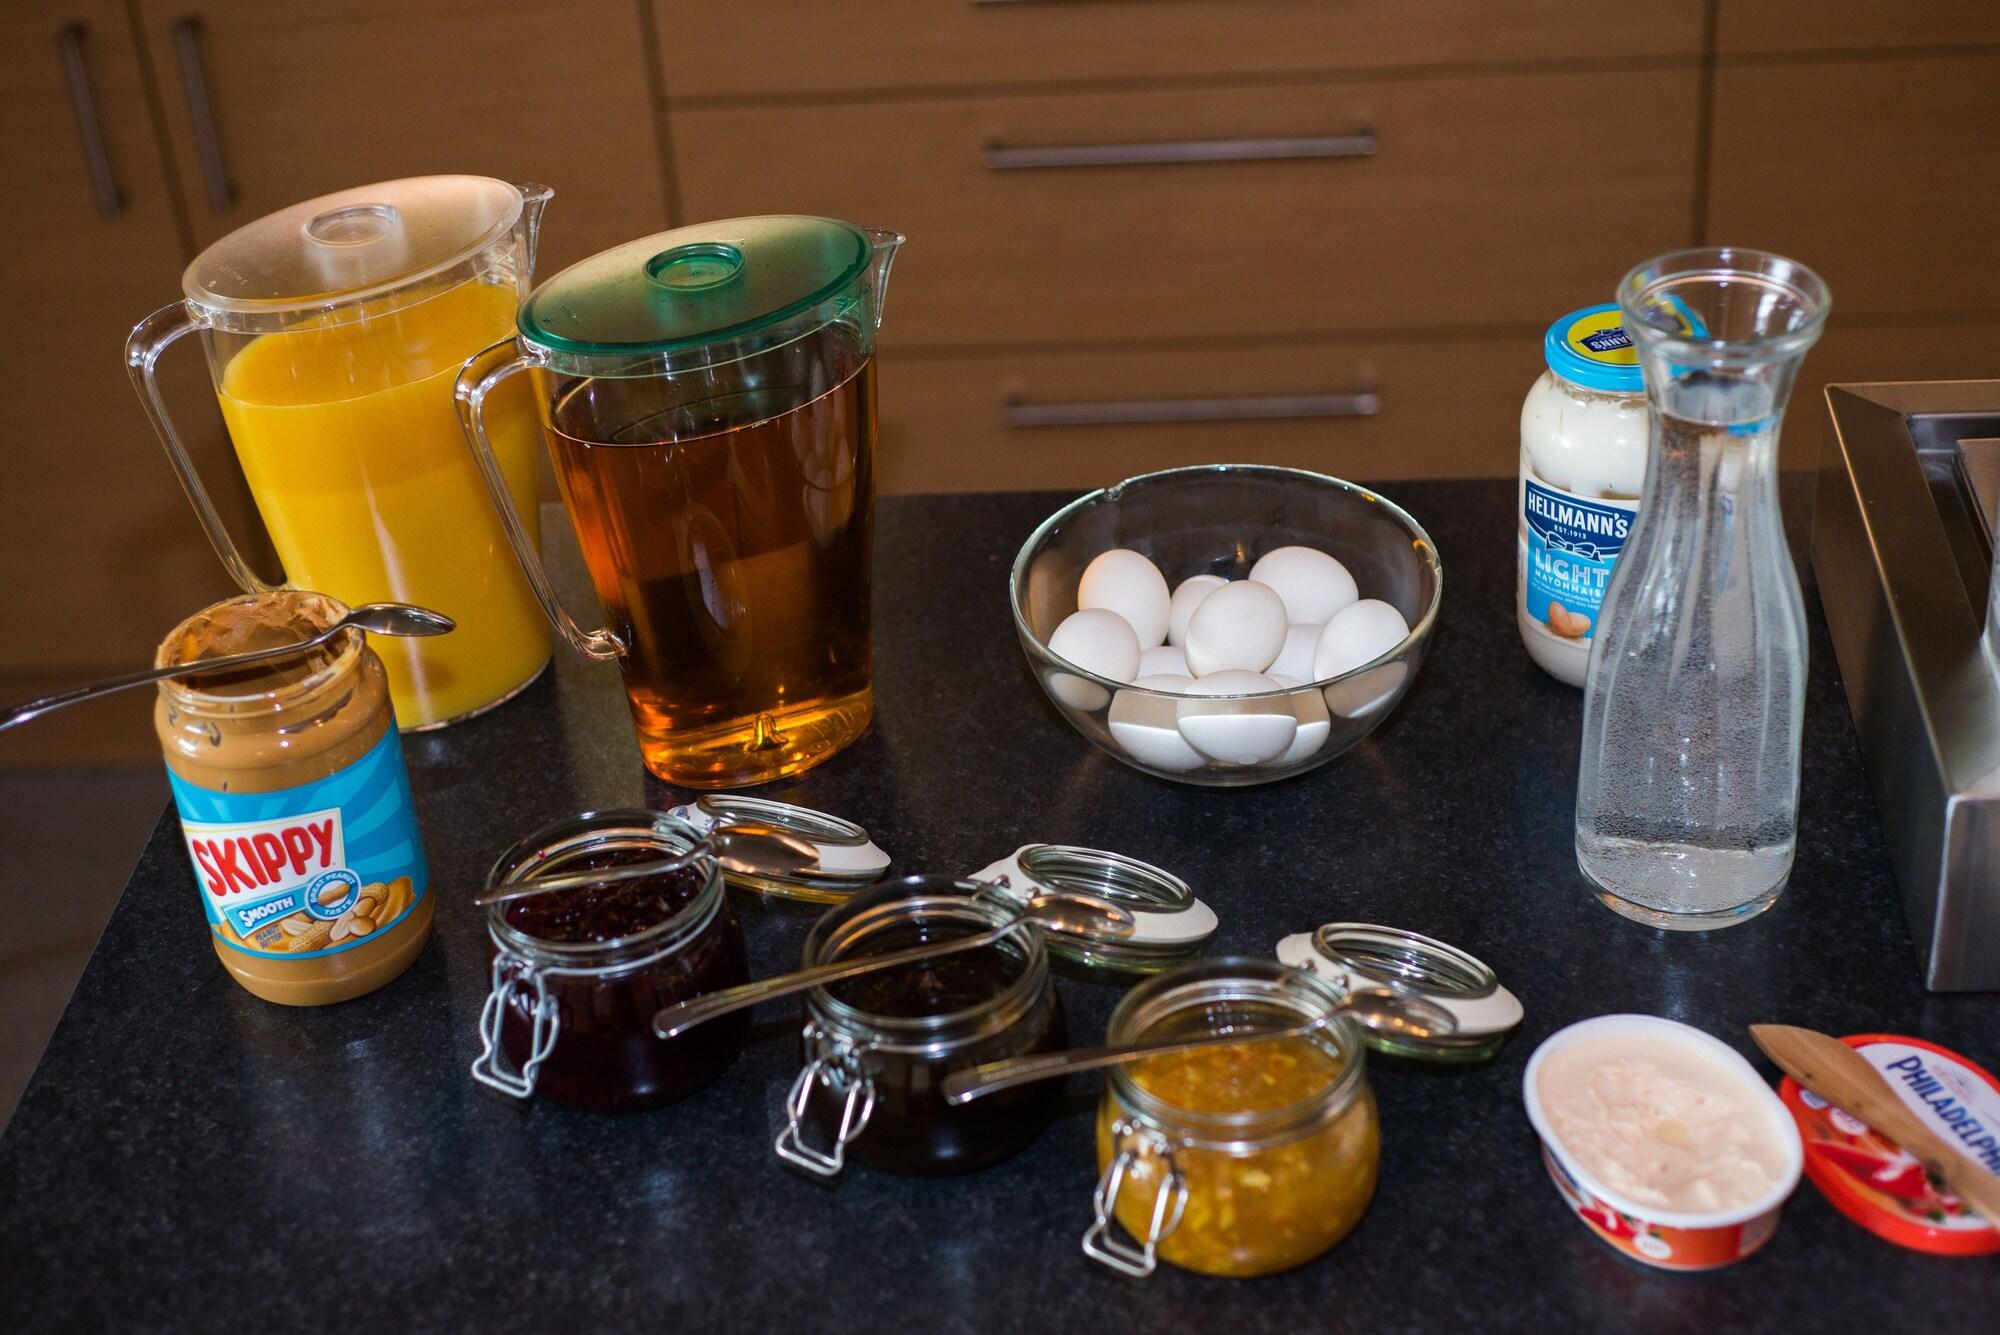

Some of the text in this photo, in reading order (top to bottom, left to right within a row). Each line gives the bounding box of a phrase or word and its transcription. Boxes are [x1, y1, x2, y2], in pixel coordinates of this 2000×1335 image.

[1528, 491, 1629, 539] HELLMANN'S
[1534, 568, 1602, 598] MAYONNAIS
[1535, 547, 1610, 588] LIGHT
[192, 818, 334, 897] SKIPPY
[238, 896, 295, 928] SMOOTH
